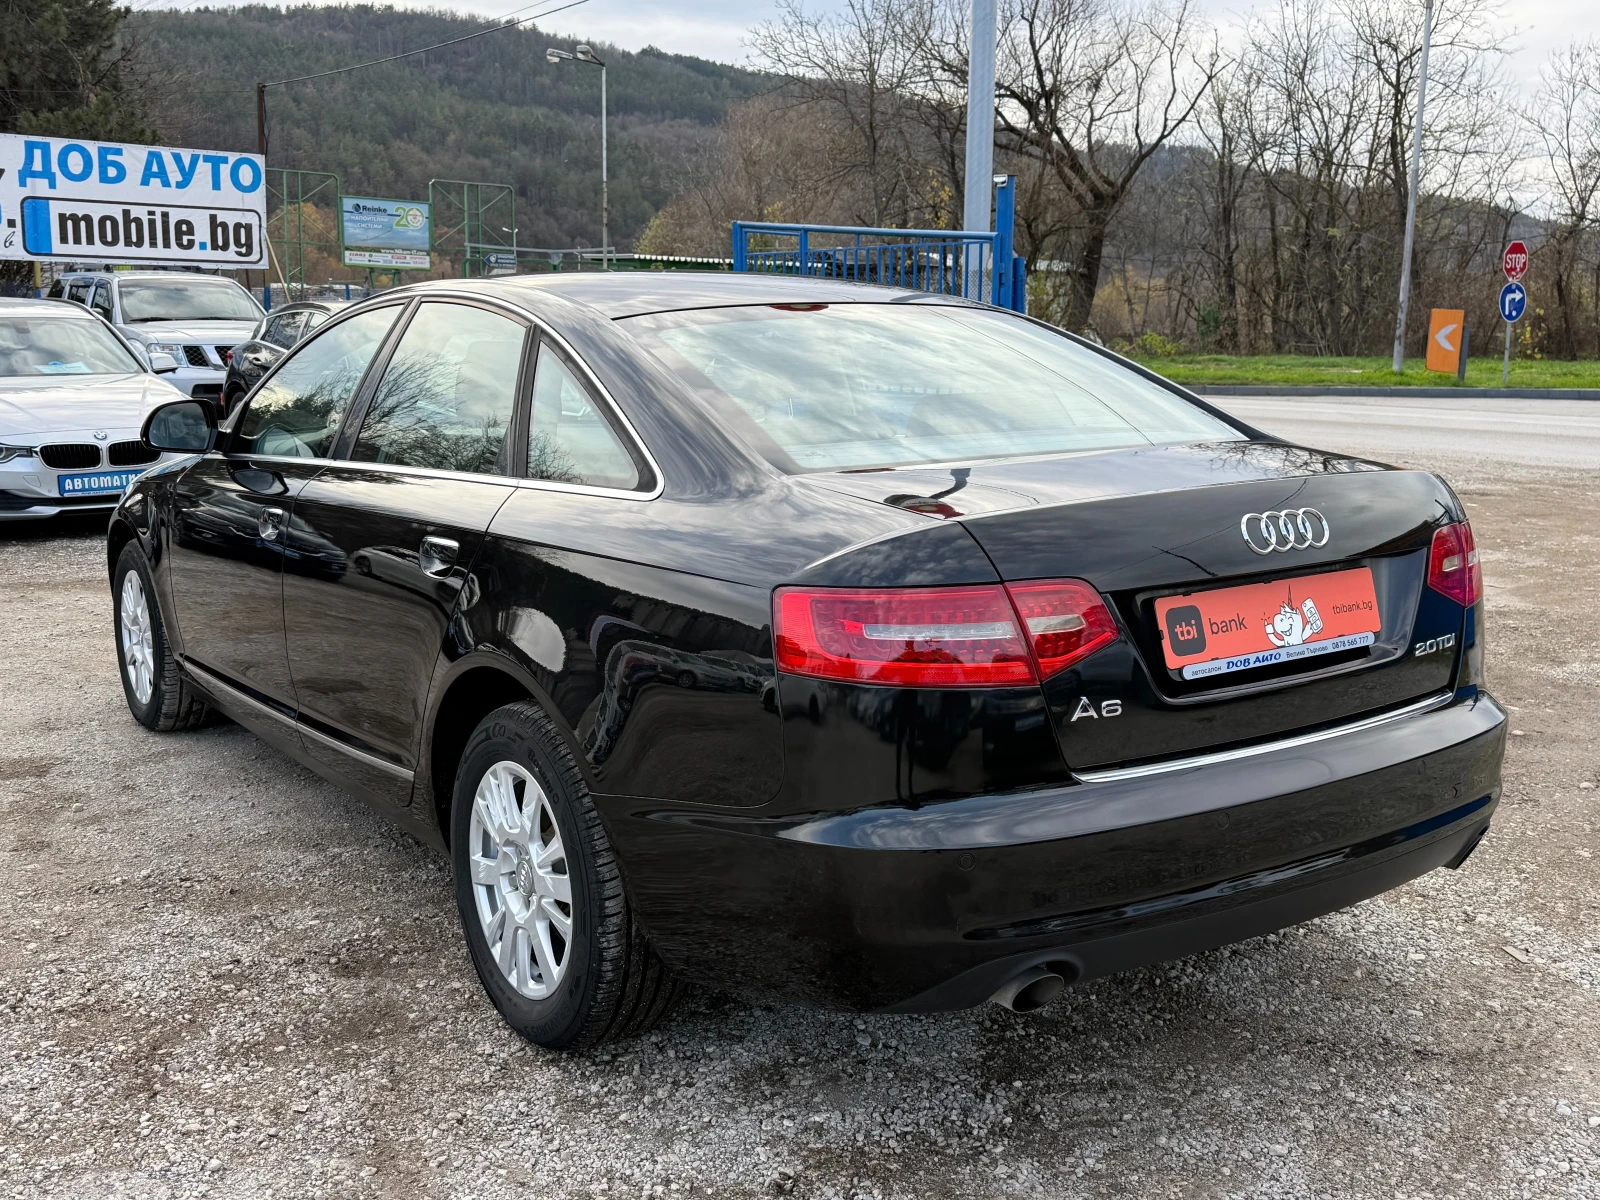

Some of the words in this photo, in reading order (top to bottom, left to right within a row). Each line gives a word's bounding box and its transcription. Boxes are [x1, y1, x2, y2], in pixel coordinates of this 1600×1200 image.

[18, 140, 127, 189] ДОБ
[140, 150, 262, 193] АУТО
[362, 205, 388, 214] Reinke
[58, 208, 254, 257] mobile.bg
[1506, 254, 1526, 269] STOP
[65, 473, 140, 491] АВТОМАТИ
[1332, 598, 1373, 615] tbibank.bg
[1174, 619, 1197, 642] tbi
[1208, 613, 1248, 636] bank
[1226, 657, 1251, 670] DOB
[1253, 652, 1282, 665] AUTO
[1286, 650, 1305, 659] Велико
[1306, 645, 1328, 655] Търново
[1331, 640, 1346, 650] 0878
[1347, 638, 1358, 647] 565
[1358, 636, 1369, 644] 777
[1070, 696, 1123, 722] A6
